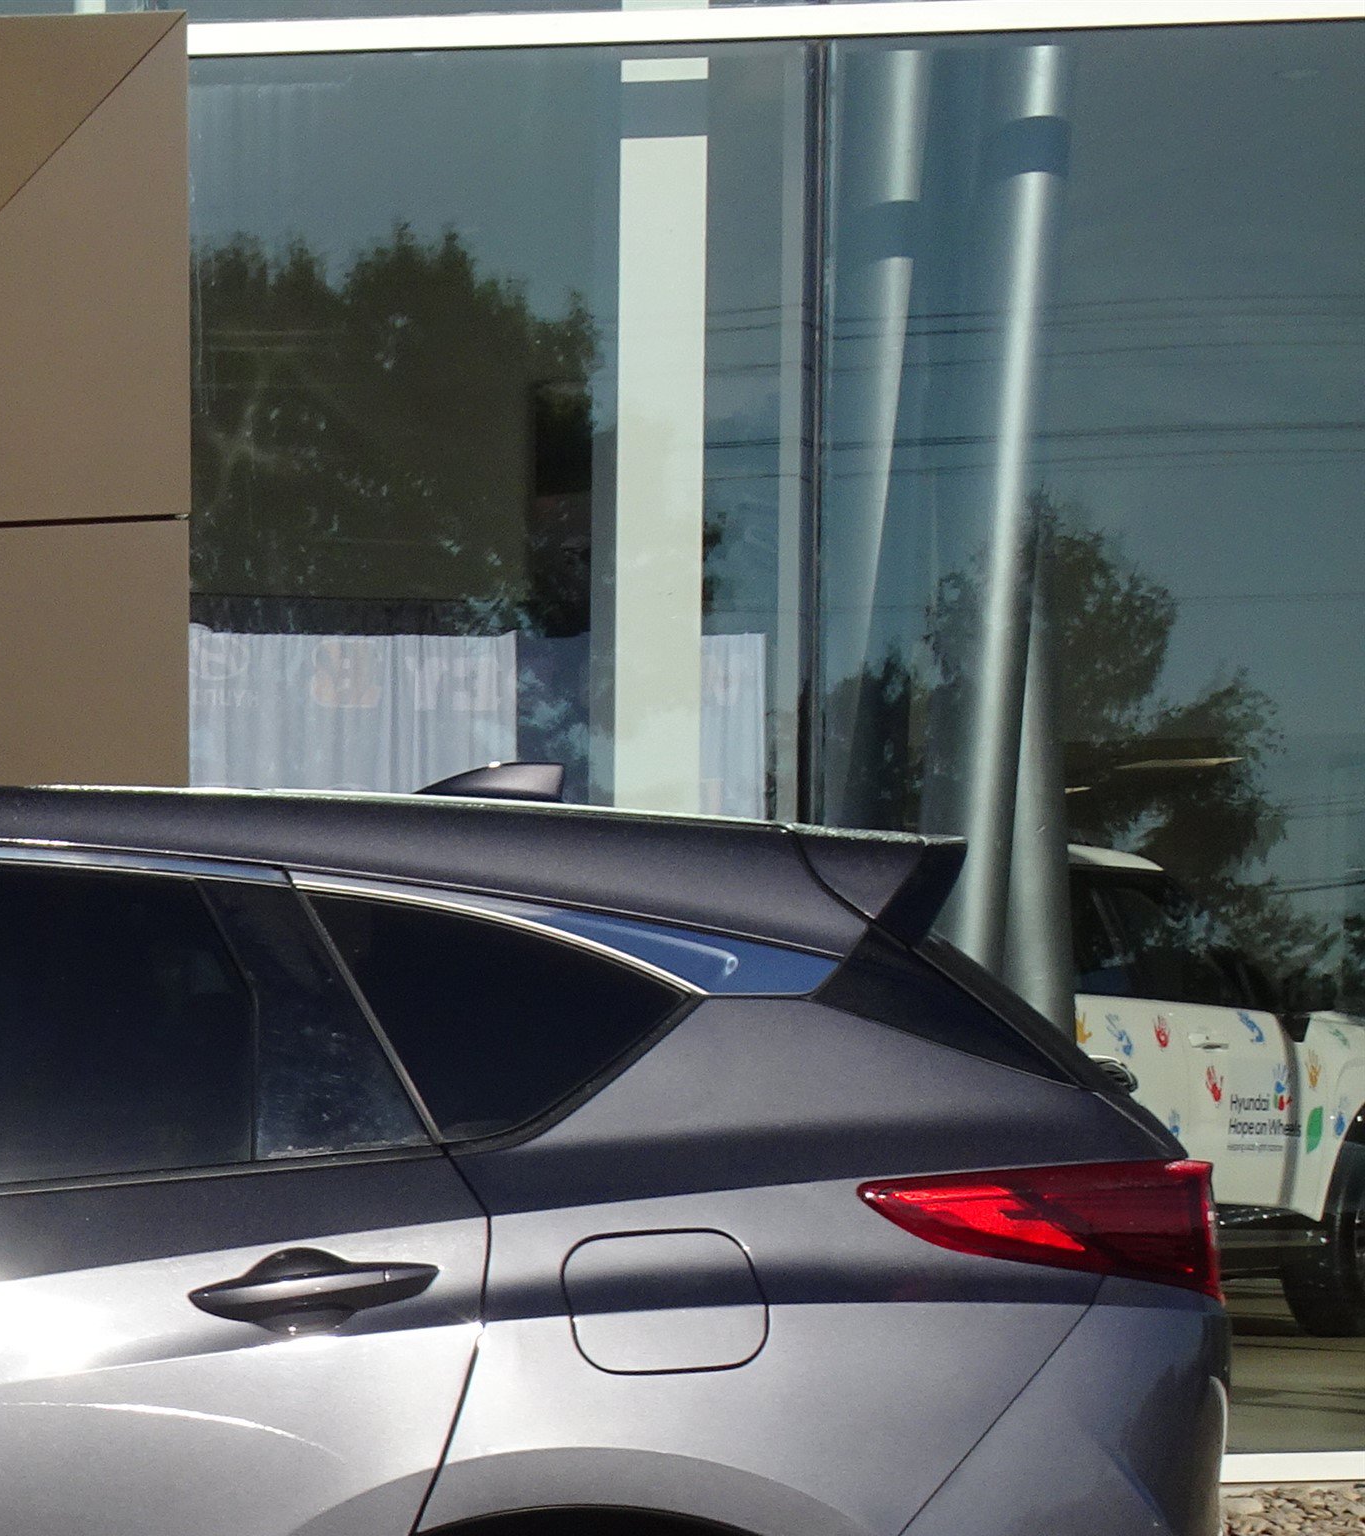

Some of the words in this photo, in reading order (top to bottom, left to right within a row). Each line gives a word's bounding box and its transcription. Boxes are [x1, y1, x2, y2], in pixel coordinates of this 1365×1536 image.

[1230, 1093, 1270, 1113] Hyundai
[1229, 1118, 1254, 1137] Hope
[1268, 1118, 1301, 1137] Wheels
